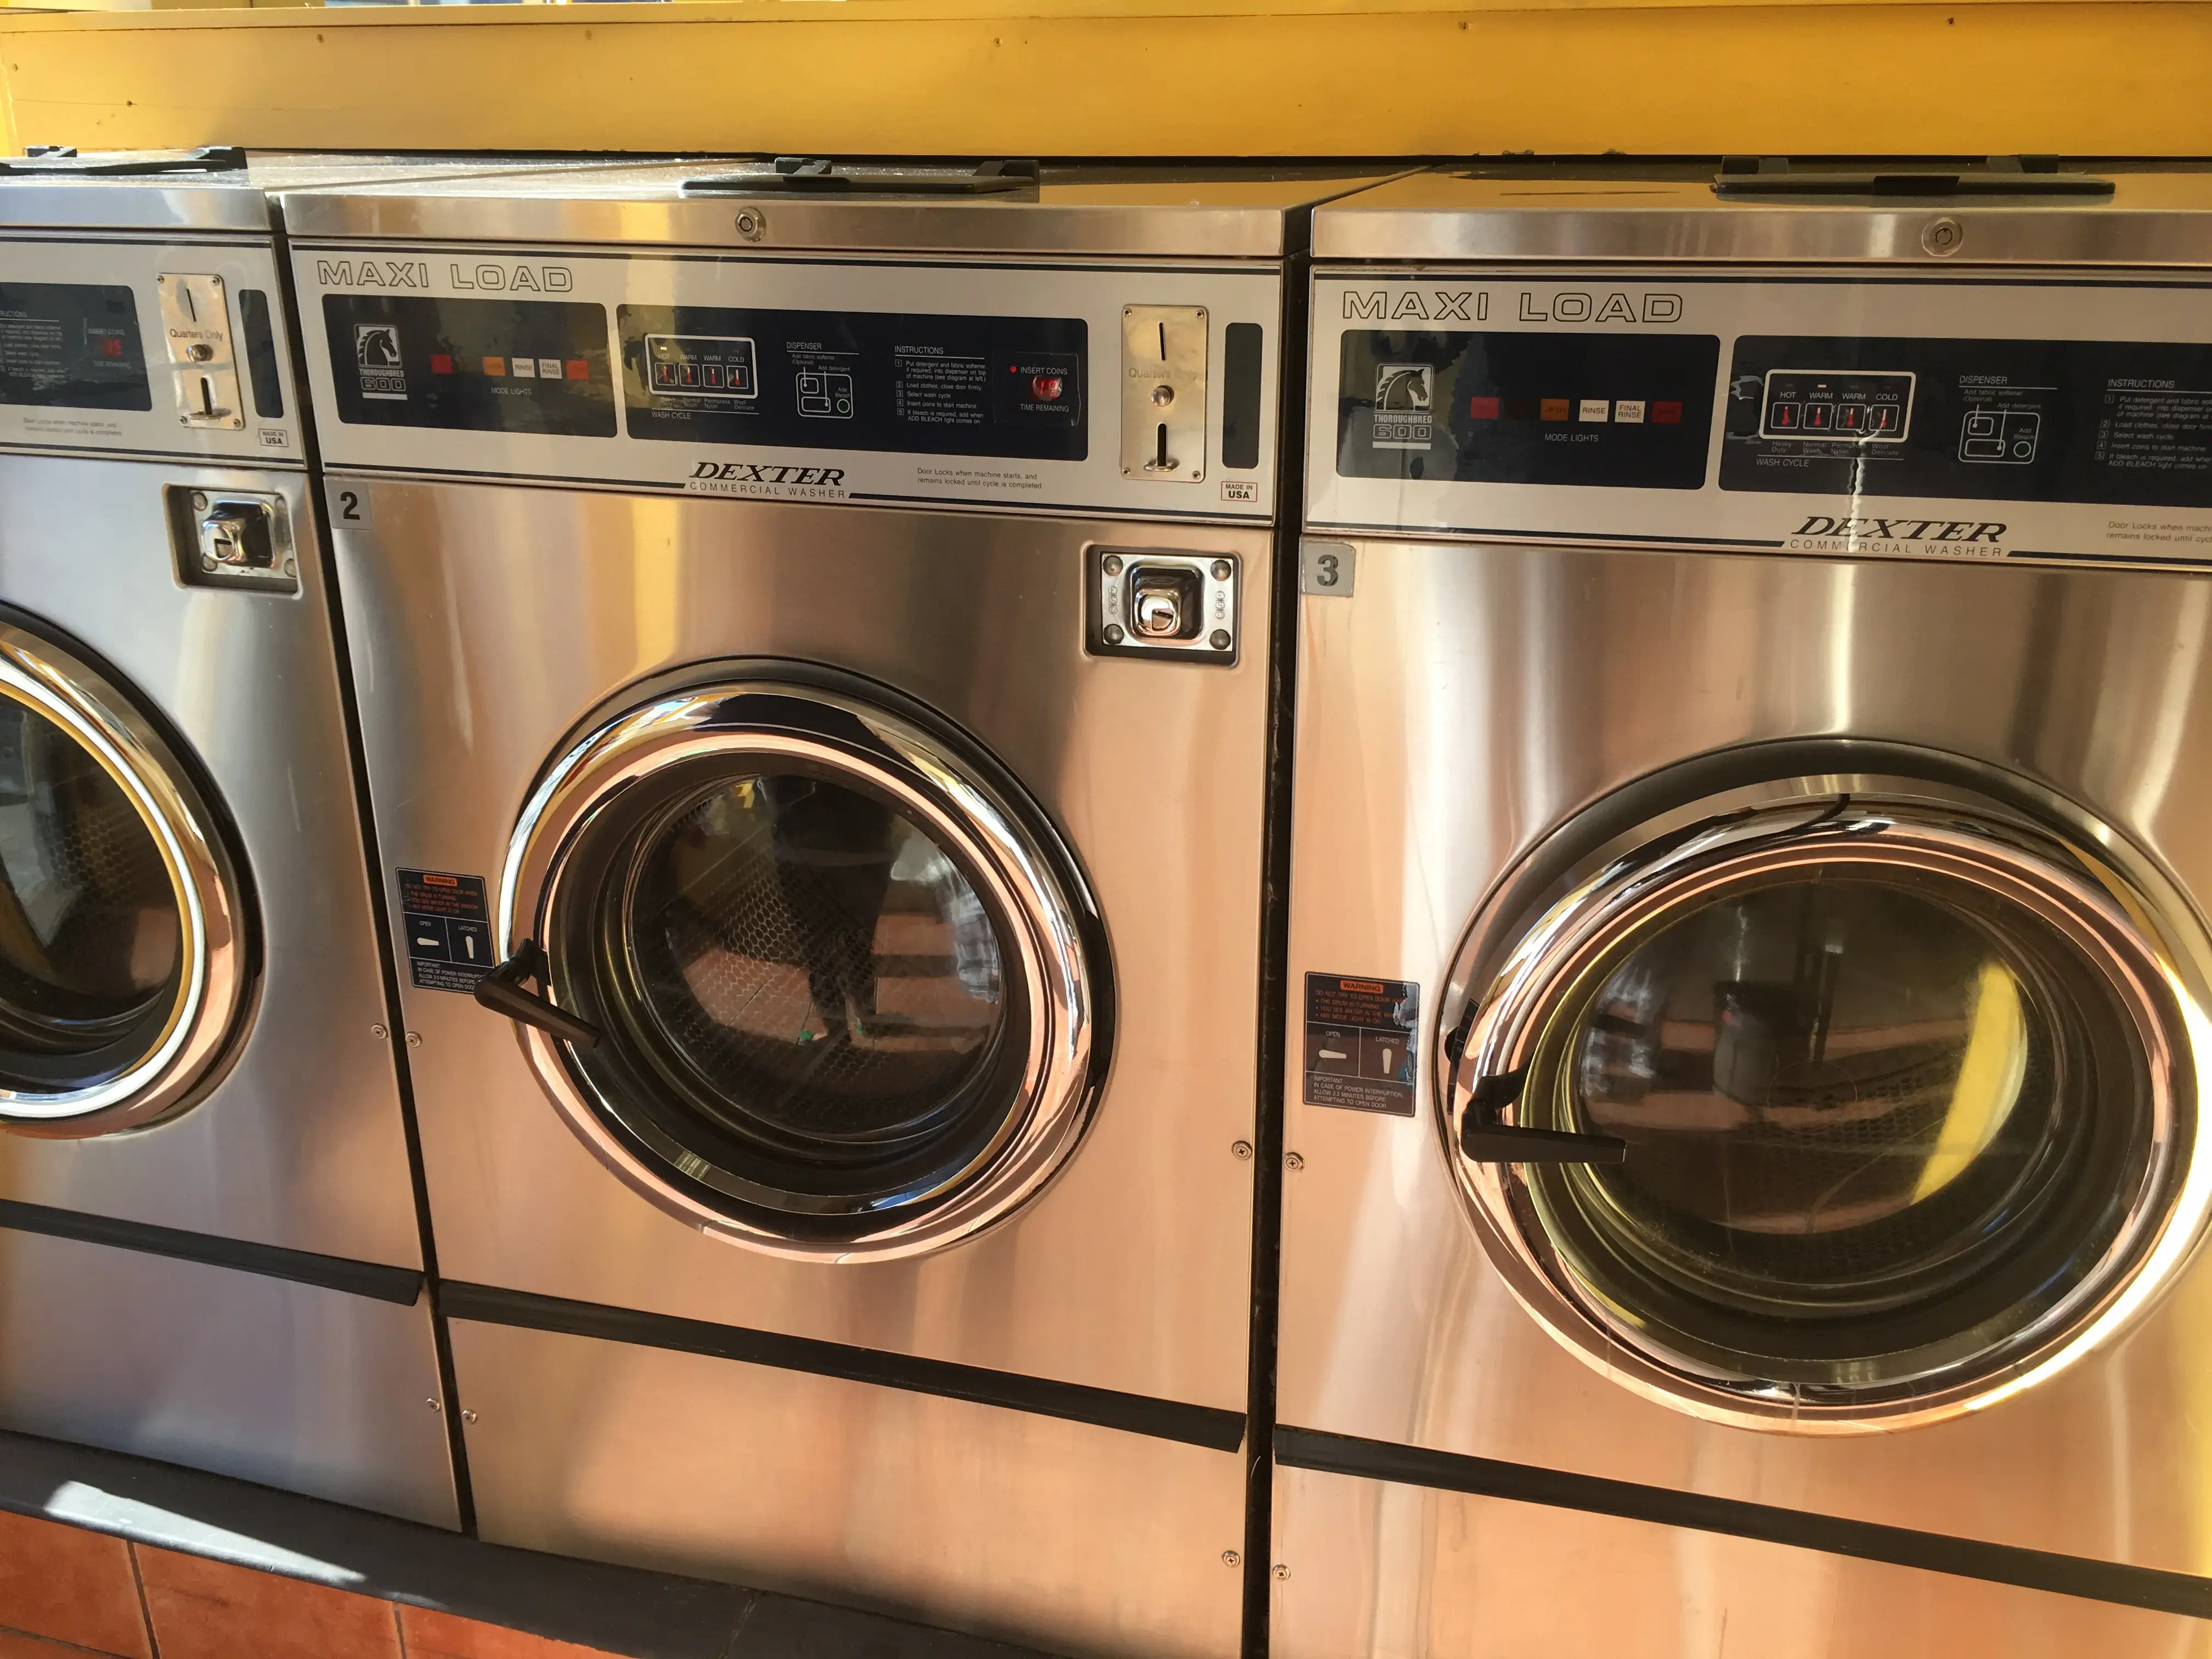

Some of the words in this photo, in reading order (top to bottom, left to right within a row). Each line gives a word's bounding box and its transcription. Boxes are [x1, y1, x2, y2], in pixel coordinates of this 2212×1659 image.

[317, 260, 429, 288] MAXI
[450, 264, 573, 292] LOAD
[1343, 291, 1488, 320] MAXI
[1519, 292, 1683, 323] LOAD
[170, 329, 203, 338] Quarters
[787, 341, 822, 349] DISPENSER
[895, 346, 944, 354] INSTRUCTIONS
[360, 377, 406, 391] 600
[1960, 375, 2007, 384] DISPENSER
[2108, 379, 2175, 388] INSTRUCTIONS
[1374, 414, 1432, 424] THOROUGHBRED
[1373, 424, 1432, 439] 600
[689, 462, 845, 486] DEXTER
[690, 482, 780, 495] COMMERCIAL
[788, 487, 845, 498] WASHER
[1229, 490, 1250, 499] USA
[340, 492, 360, 520] 2
[1791, 516, 2007, 543] DEXTER
[1925, 545, 2001, 557] WASHER
[1317, 555, 1339, 586] 3
[1344, 983, 1380, 992] WARNING
[1313, 1095, 1344, 1103] ATTEMPTING
